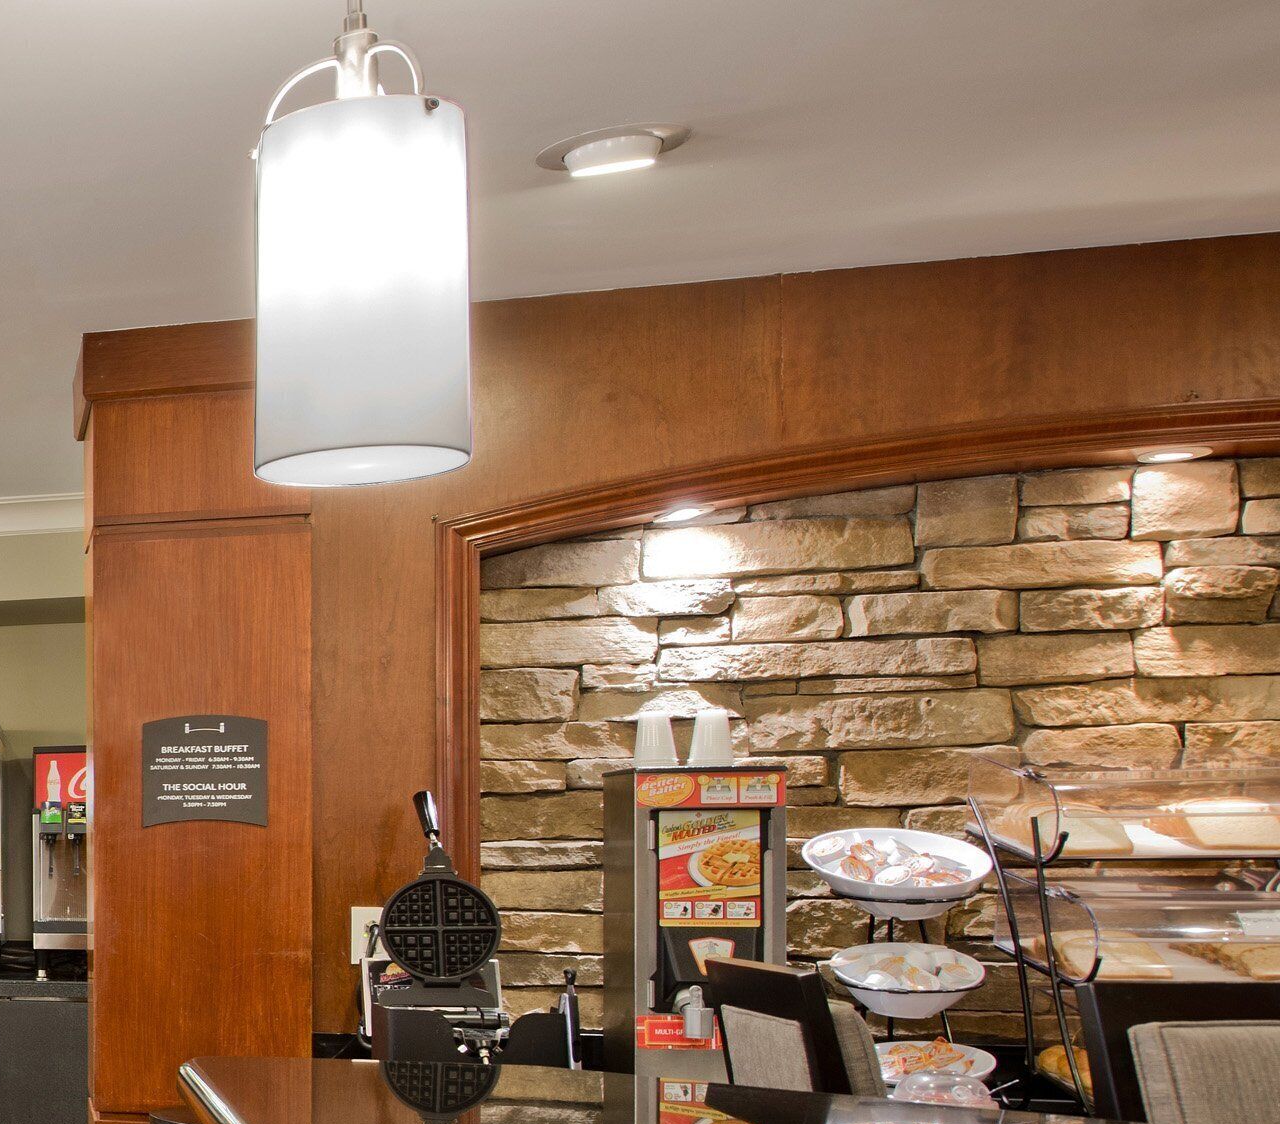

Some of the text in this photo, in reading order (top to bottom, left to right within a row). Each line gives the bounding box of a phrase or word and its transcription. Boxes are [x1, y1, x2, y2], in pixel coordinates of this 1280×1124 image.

[161, 744, 249, 754] BREAKFAST BUFFET
[162, 782, 247, 791] THE SOCIAL HOUR
[671, 824, 718, 841] MALTED
[677, 841, 701, 852] Simply
[703, 838, 715, 846] the
